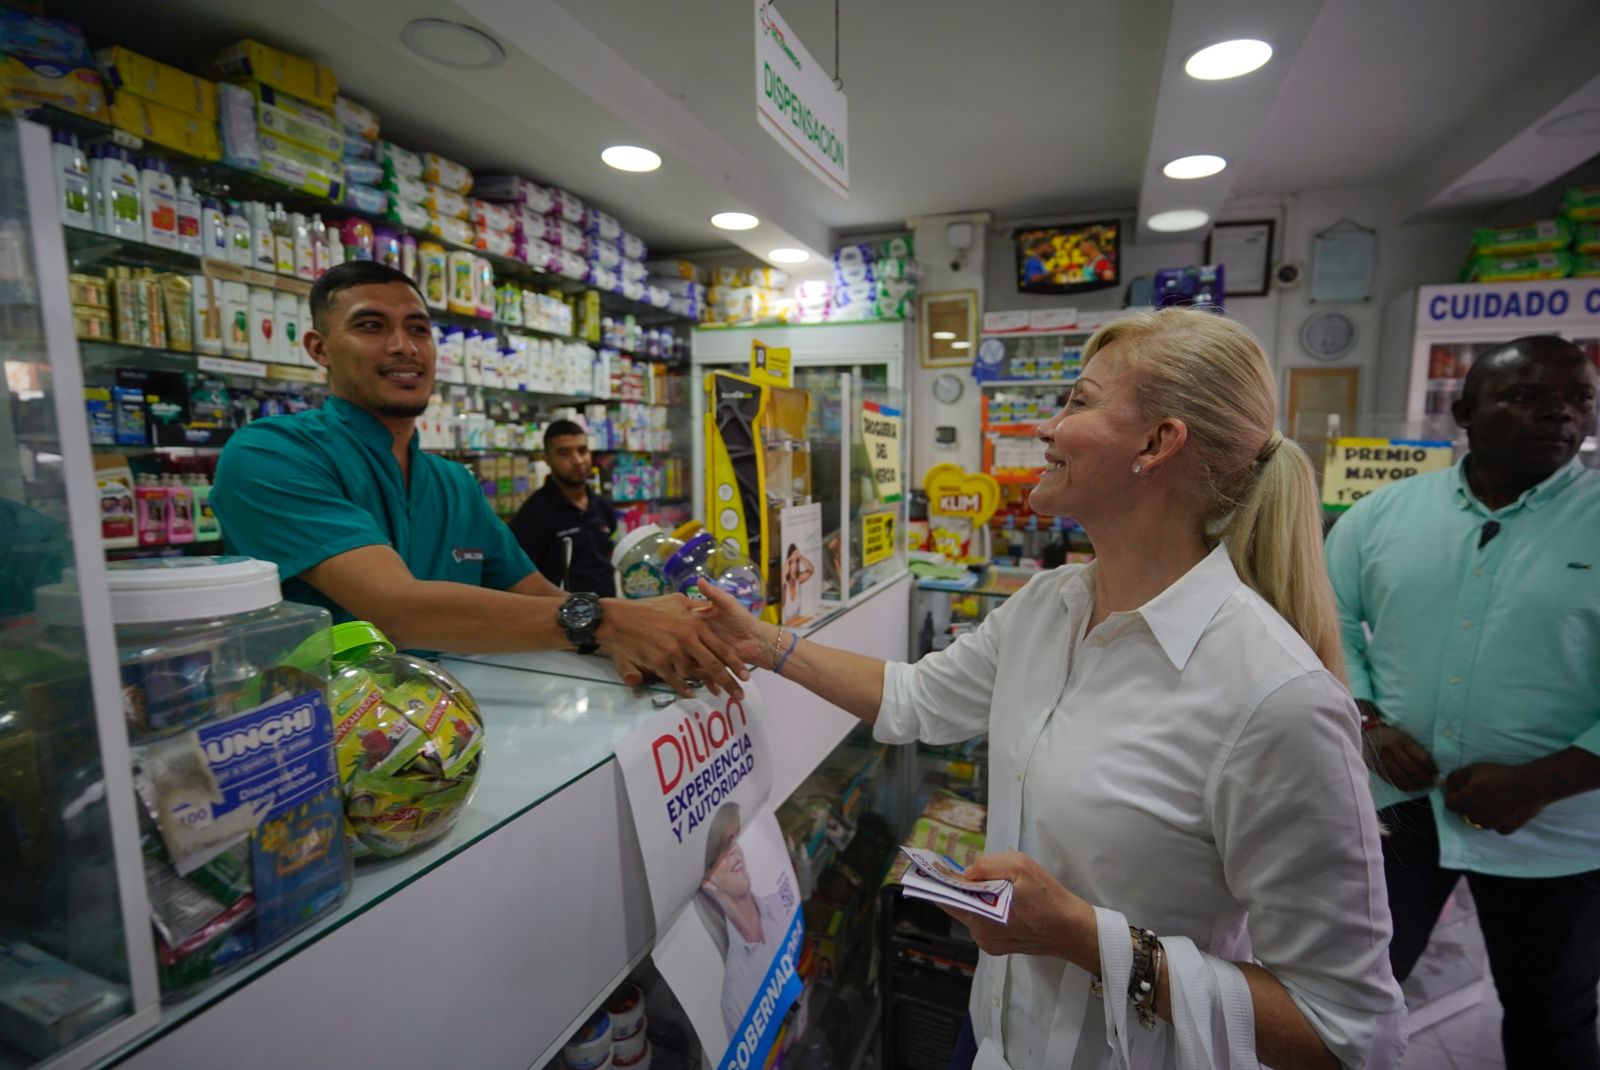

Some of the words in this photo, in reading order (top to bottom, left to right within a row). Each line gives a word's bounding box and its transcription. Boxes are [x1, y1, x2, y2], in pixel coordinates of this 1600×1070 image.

[764, 60, 845, 171] DISPENSACIÓN
[1429, 288, 1570, 321] CUIDADO
[1345, 448, 1427, 462] PREMIO
[940, 493, 981, 513] KLIM
[202, 705, 313, 764] UNCHI
[652, 696, 747, 796] Dilian
[666, 732, 753, 824] EXPERIENCIA
[672, 821, 684, 844] Y
[687, 754, 755, 834] AUTORIDAD
